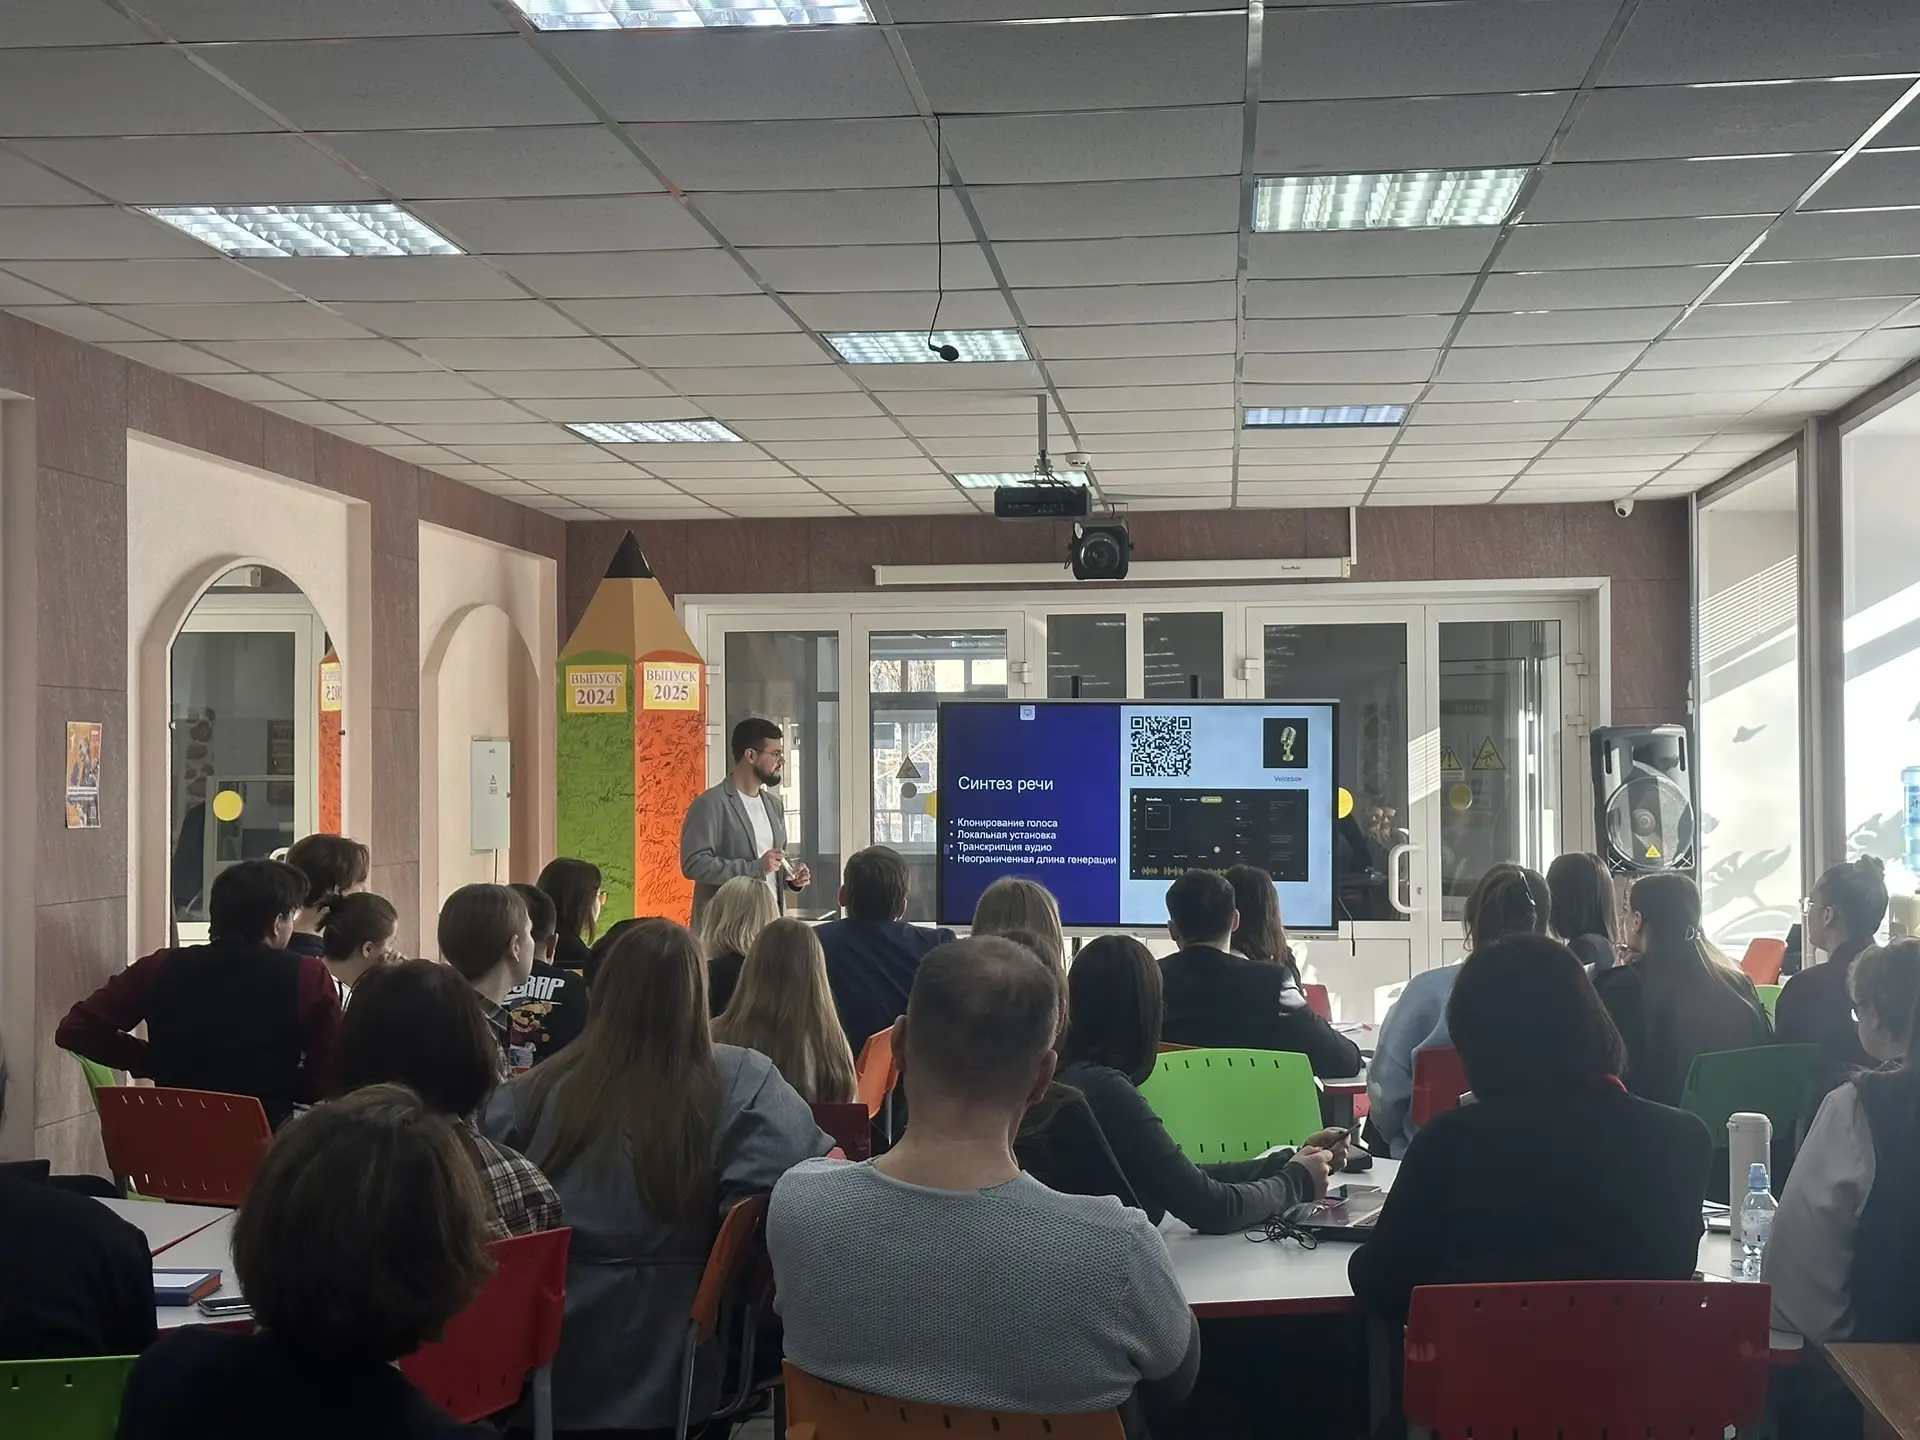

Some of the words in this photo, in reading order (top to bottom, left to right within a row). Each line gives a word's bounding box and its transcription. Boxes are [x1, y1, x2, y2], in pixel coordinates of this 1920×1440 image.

[571, 673, 623, 685] ВЫПУСК
[646, 670, 697, 682] ВЫПУСК
[576, 688, 616, 705] 2024
[654, 684, 689, 700] 2025
[958, 776, 1013, 790] Синтез
[1017, 779, 1054, 794] речи
[957, 817, 1025, 829] Клонирование
[1026, 819, 1058, 828] голоса
[957, 829, 1008, 840] Локальная
[1009, 831, 1057, 841] установка
[957, 841, 1023, 853] Транскрипция
[1024, 844, 1053, 854] аудио
[957, 853, 1035, 865] Неограниченная
[1036, 855, 1065, 865] длина
[1067, 856, 1117, 866] генерации
